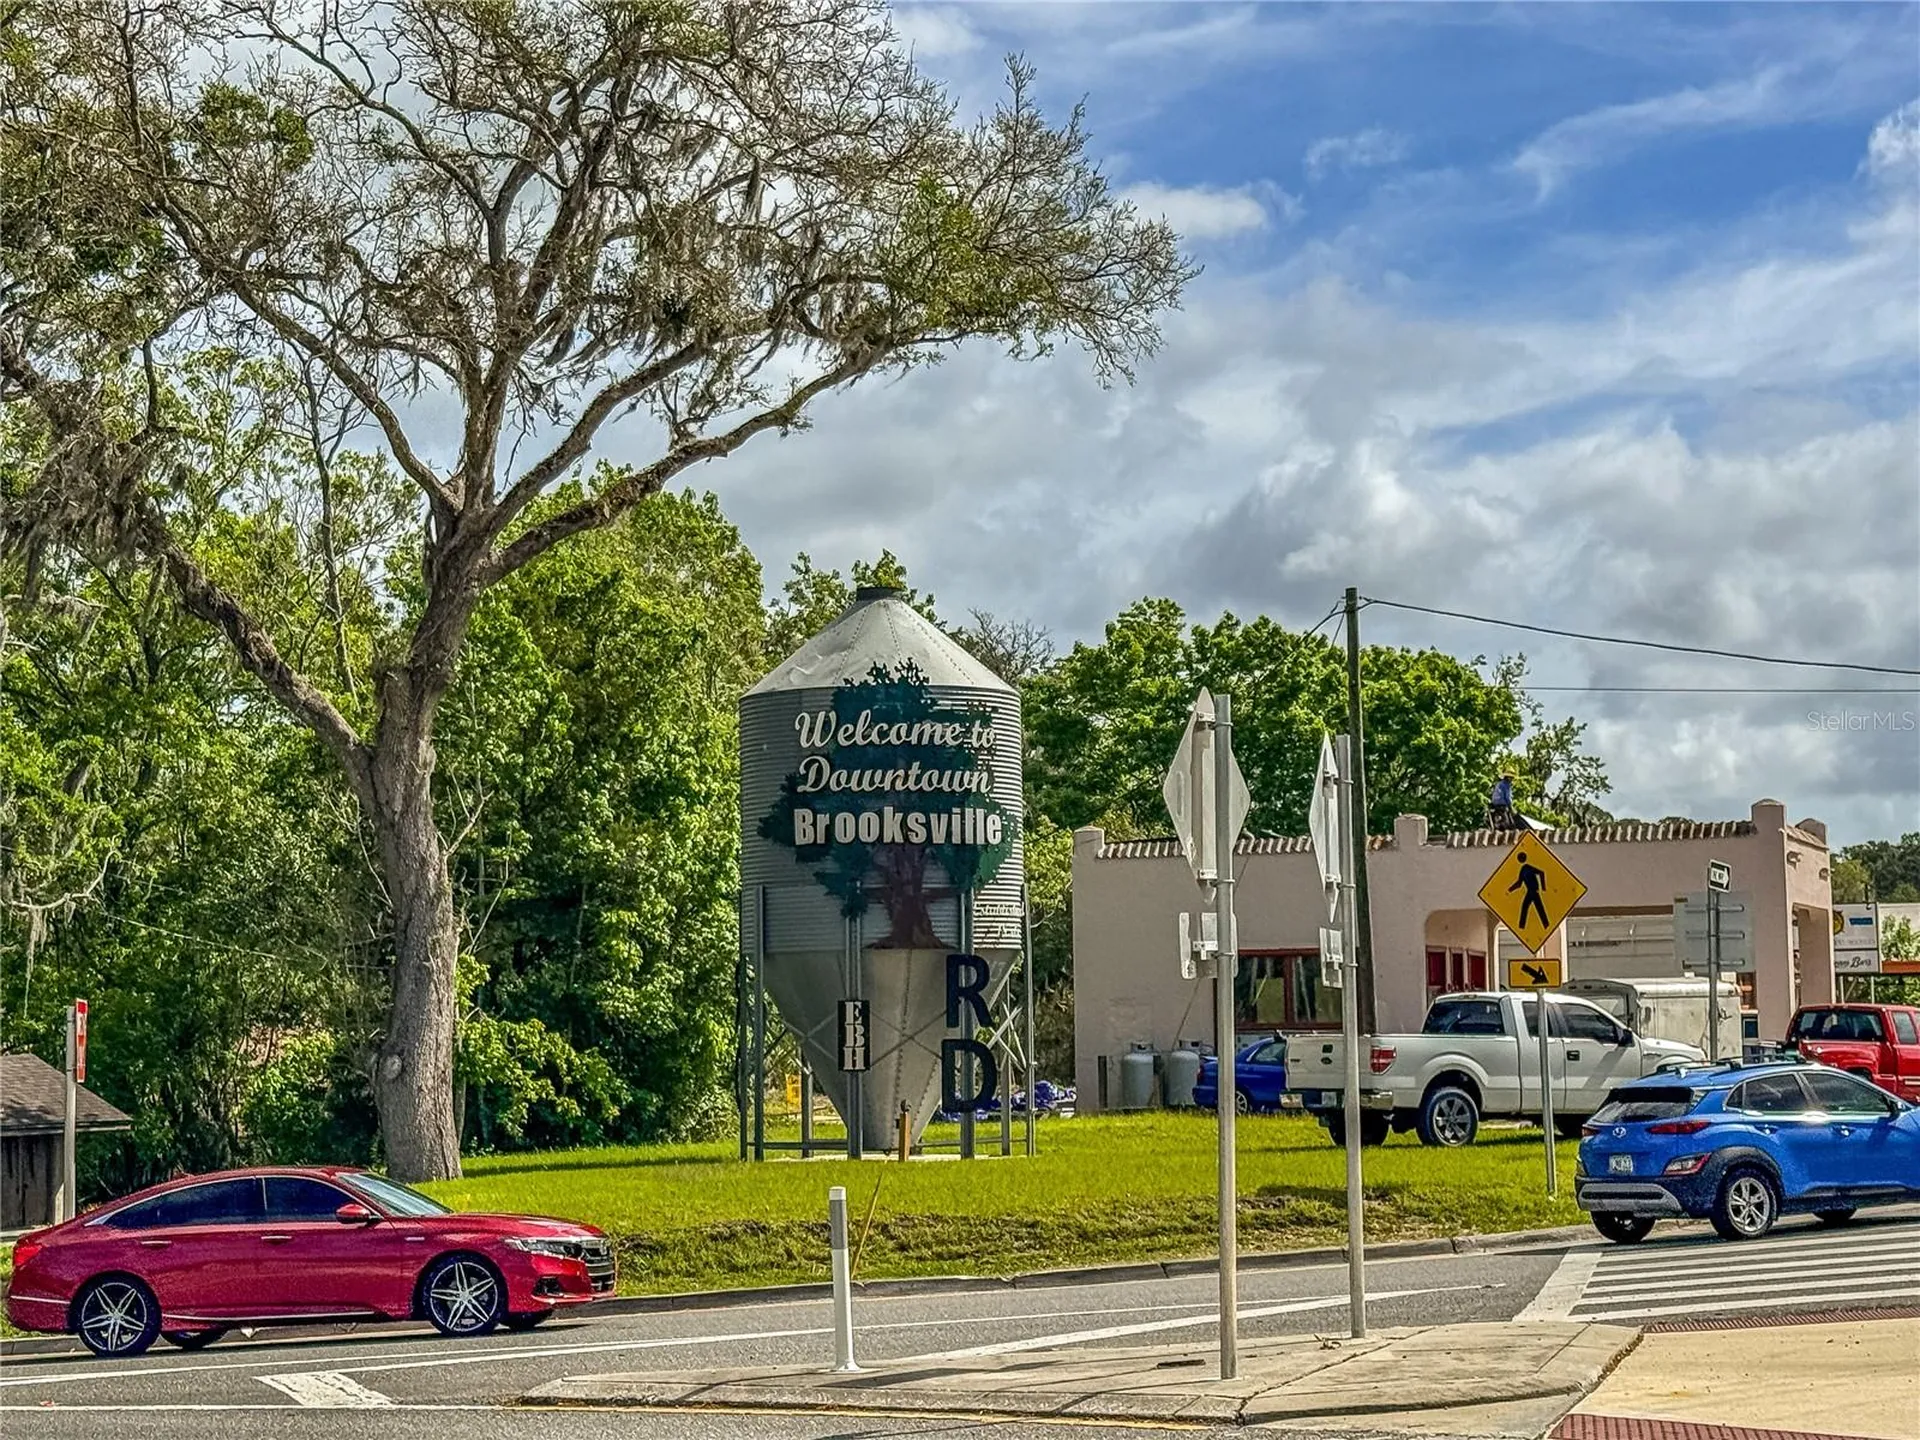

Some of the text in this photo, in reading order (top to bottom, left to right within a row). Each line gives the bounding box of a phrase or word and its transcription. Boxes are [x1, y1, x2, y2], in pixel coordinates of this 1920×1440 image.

[795, 709, 996, 748] Welcome to
[797, 755, 992, 793] Downtown
[794, 806, 1002, 846] Brooksville
